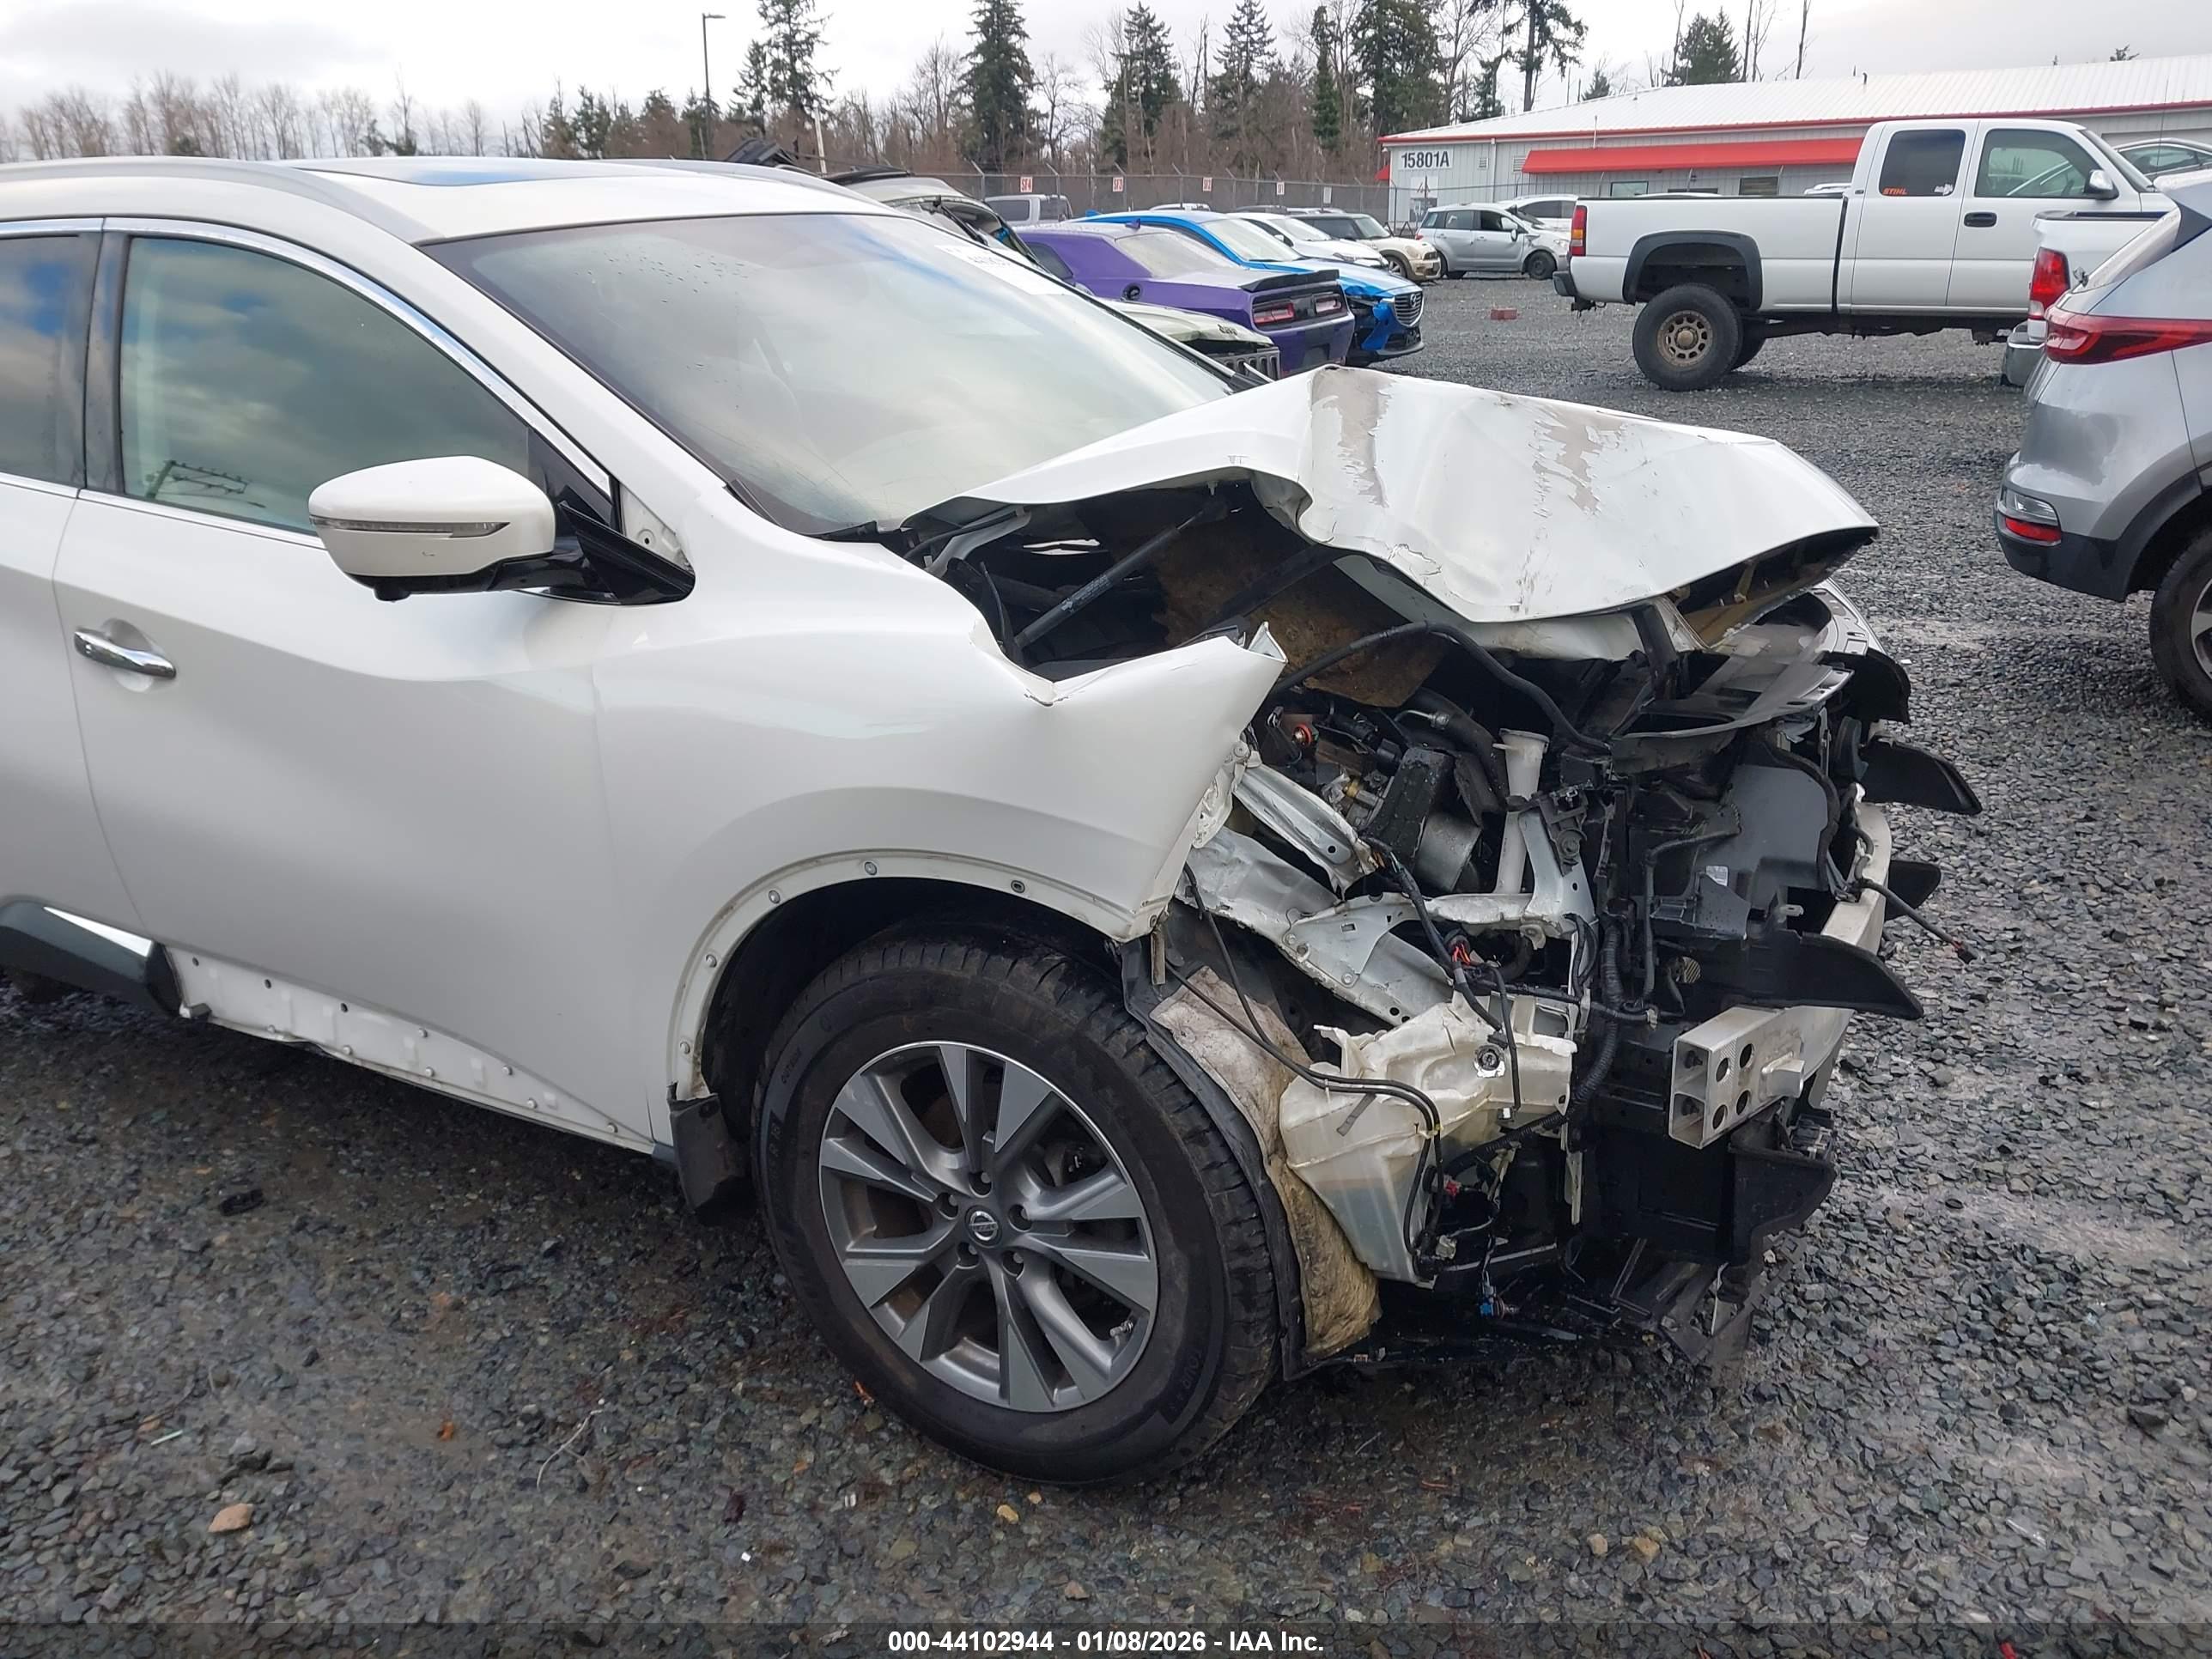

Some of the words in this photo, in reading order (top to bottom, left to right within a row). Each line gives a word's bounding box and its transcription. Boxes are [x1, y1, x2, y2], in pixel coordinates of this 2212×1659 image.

[1401, 150, 1450, 169] 15801A
[1021, 178, 1032, 191] SF4
[1113, 178, 1122, 190] SF3
[1882, 187, 1907, 196] STIHL
